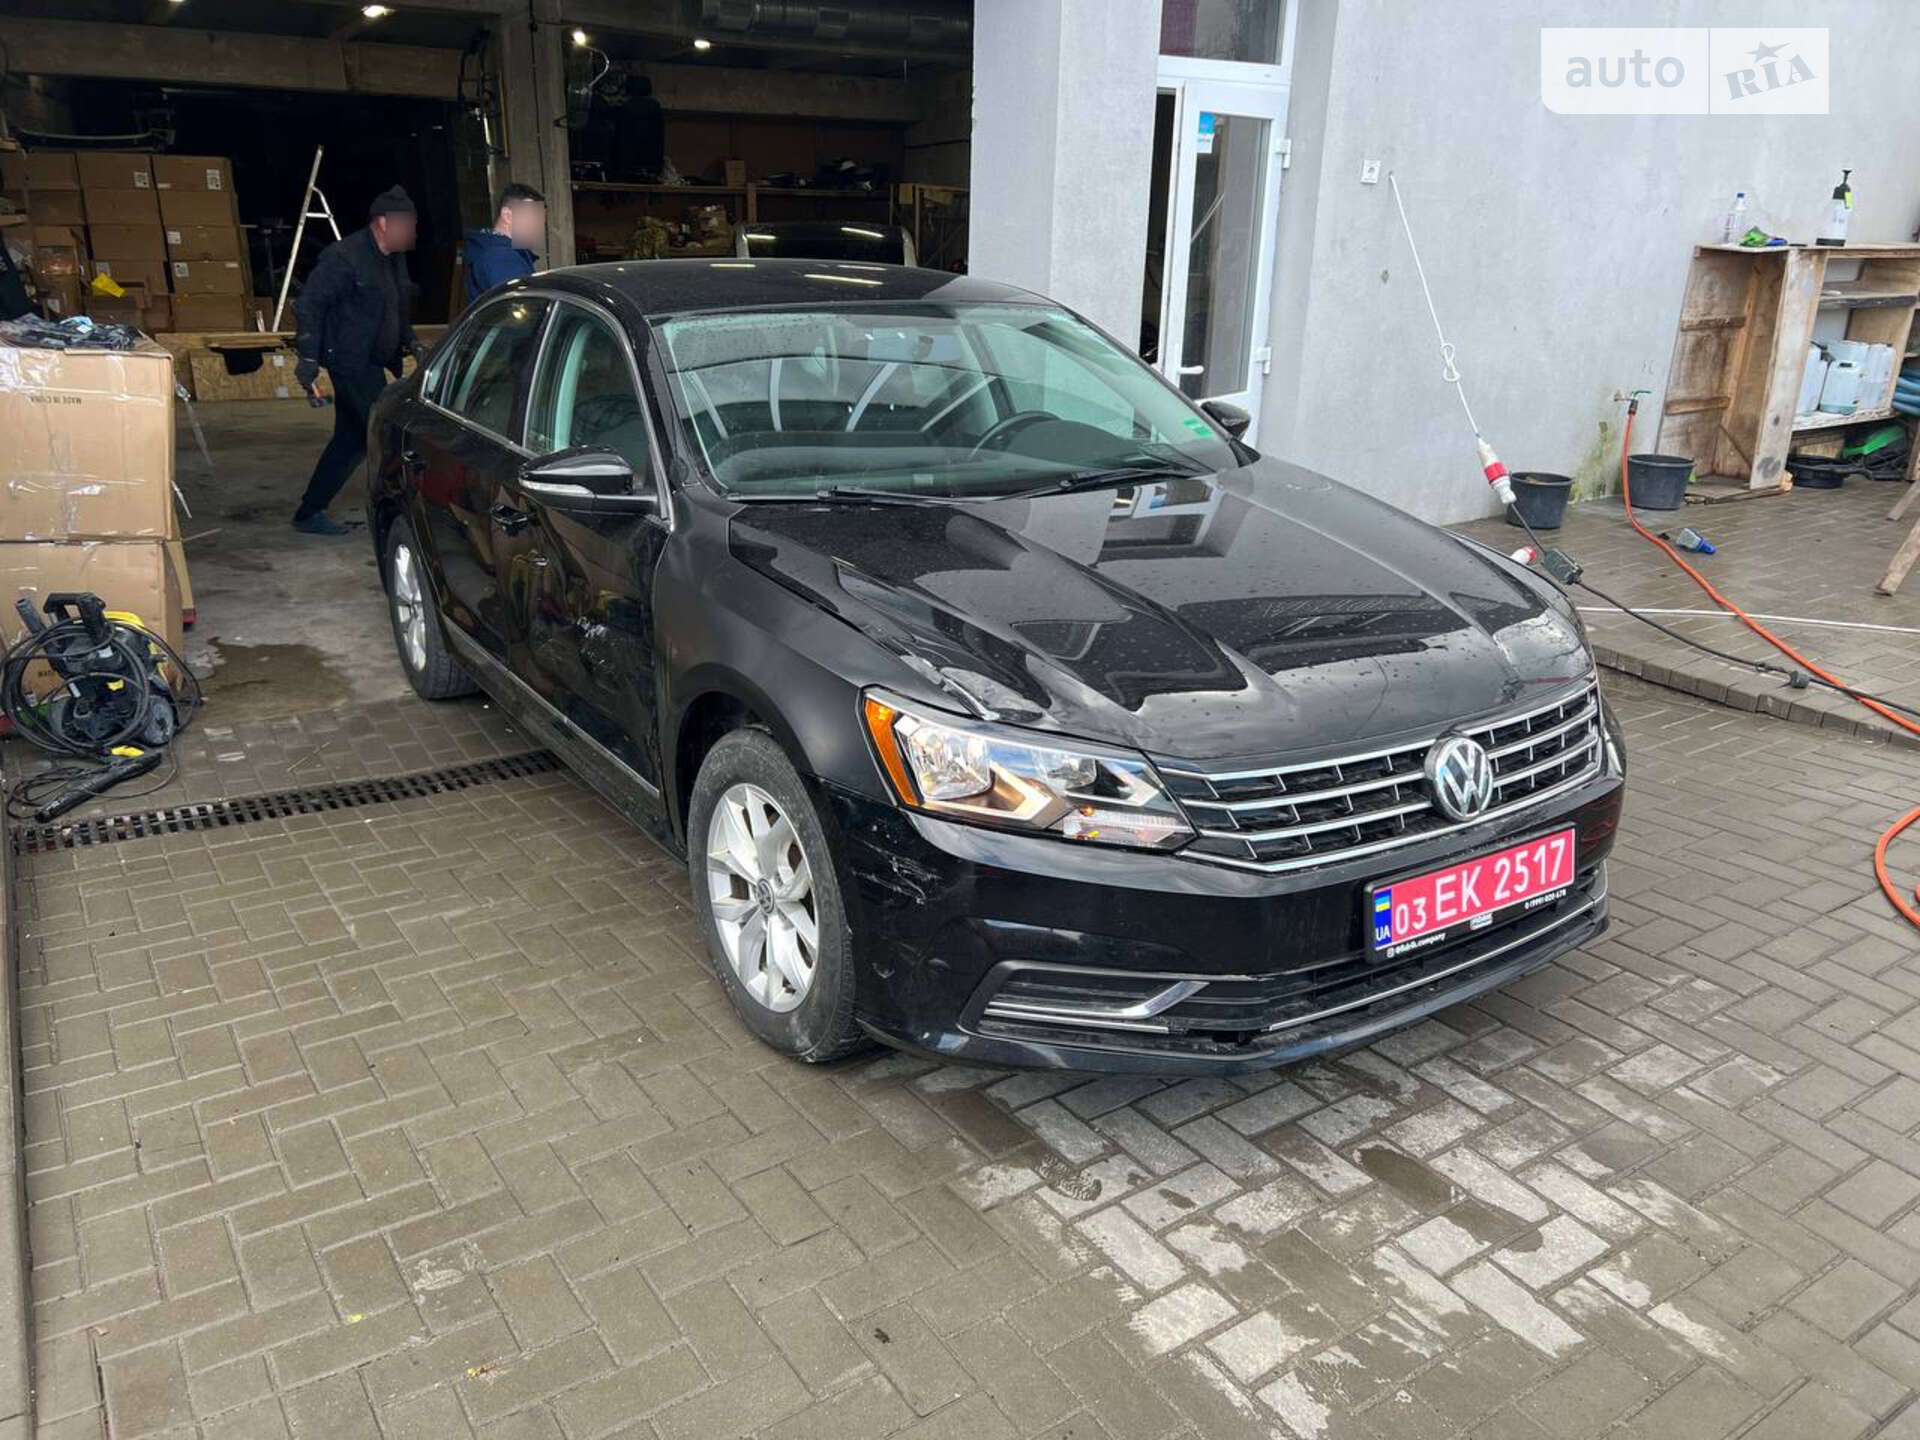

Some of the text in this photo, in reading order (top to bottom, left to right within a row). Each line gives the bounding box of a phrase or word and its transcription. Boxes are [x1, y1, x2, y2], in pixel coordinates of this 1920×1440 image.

[1395, 838, 1566, 935] 03 EK 2517
[1375, 925, 1391, 941] UA
